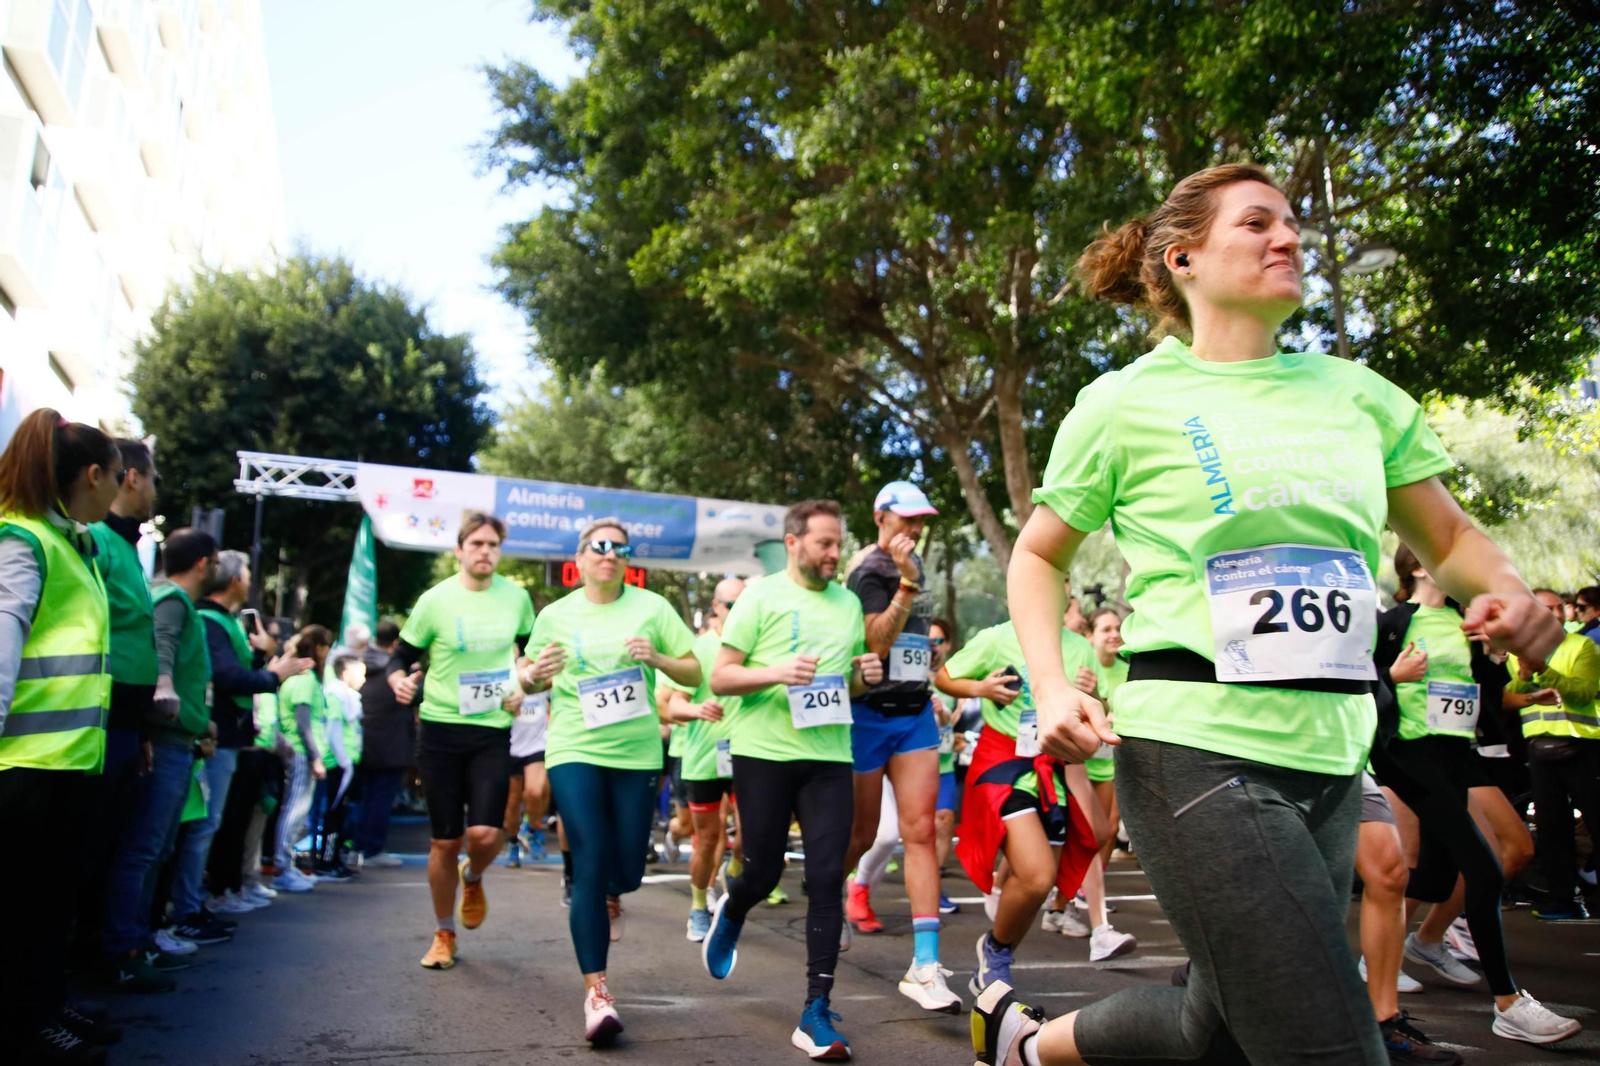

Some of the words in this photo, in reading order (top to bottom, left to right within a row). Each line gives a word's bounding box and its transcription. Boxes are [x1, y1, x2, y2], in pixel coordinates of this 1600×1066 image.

[1221, 433, 1257, 451] En
[1260, 428, 1349, 448] marcha
[1182, 415, 1237, 515] ALMERÍA
[1234, 449, 1328, 475] contra
[1333, 444, 1360, 467] el
[1243, 475, 1367, 511] cáncer
[505, 511, 572, 532] contra
[1214, 567, 1257, 582] contra
[1258, 565, 1272, 577] el
[1273, 564, 1311, 574] cáncer
[1249, 588, 1352, 635] 266
[471, 682, 504, 699] 755
[594, 685, 636, 709] 312
[803, 690, 841, 709] 204
[1440, 698, 1474, 716] 793
